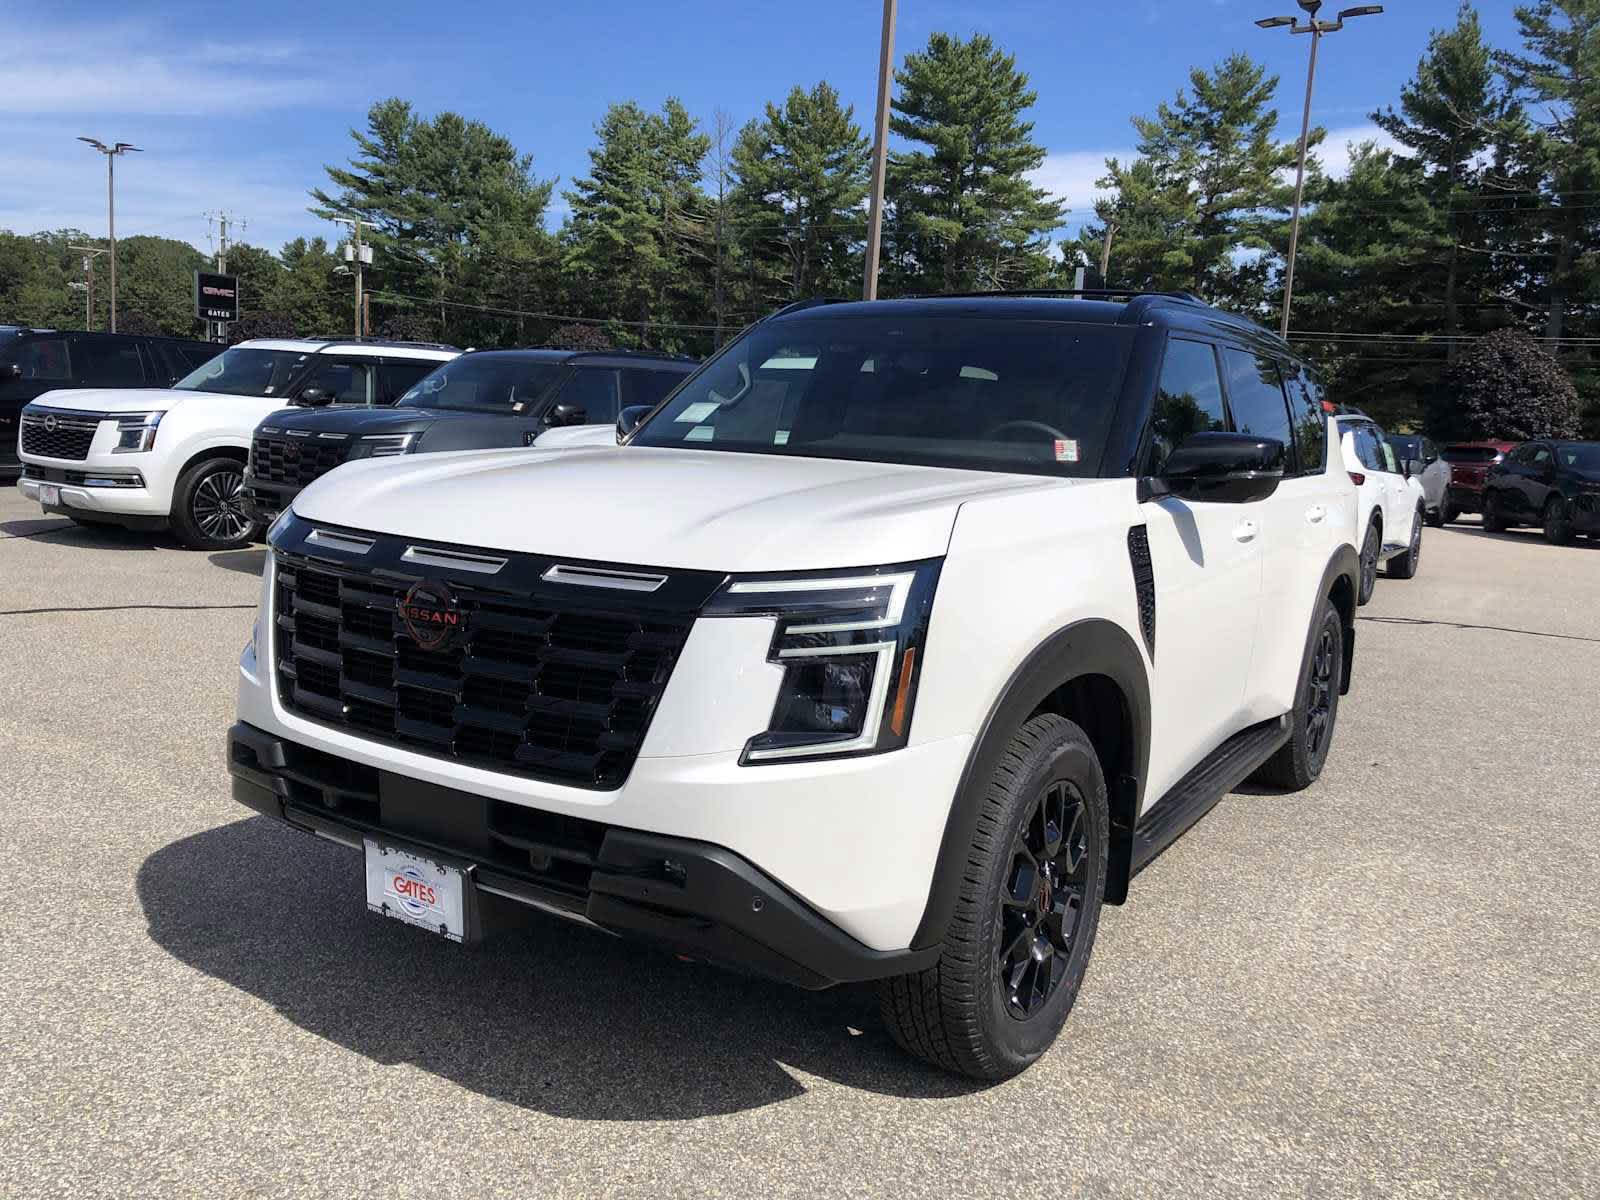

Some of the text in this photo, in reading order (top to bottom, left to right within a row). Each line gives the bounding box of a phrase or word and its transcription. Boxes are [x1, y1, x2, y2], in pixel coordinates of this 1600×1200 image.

[203, 286, 235, 297] GMC
[207, 309, 230, 318] GATES
[393, 876, 436, 904] GATES
